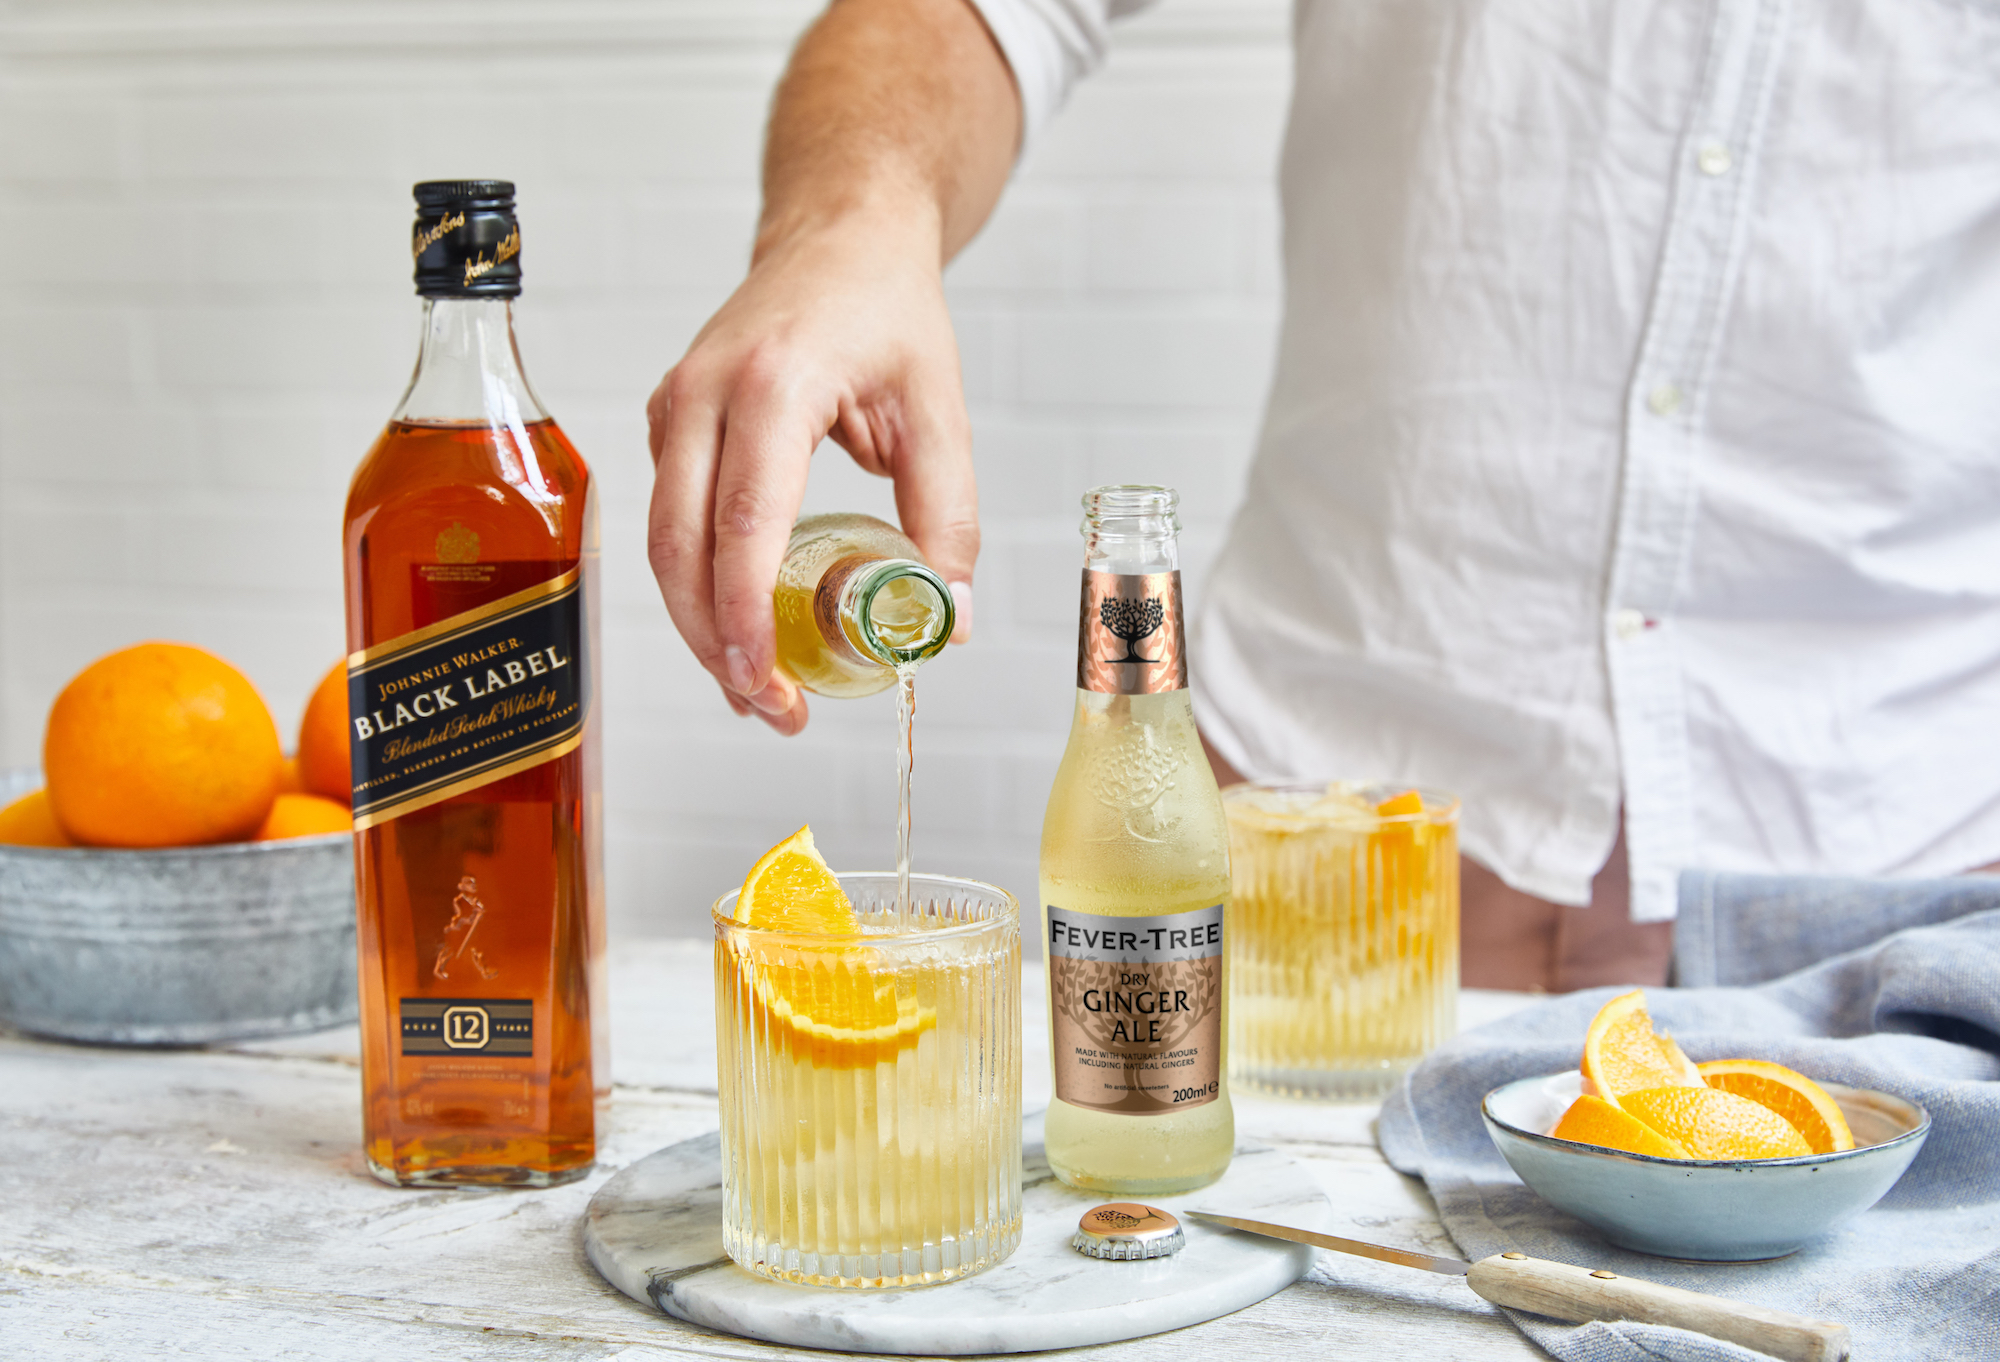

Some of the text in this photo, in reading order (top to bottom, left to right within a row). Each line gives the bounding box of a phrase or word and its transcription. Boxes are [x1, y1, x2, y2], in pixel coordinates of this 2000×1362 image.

[378, 636, 521, 701] JOHNNIE WALKER
[354, 645, 568, 741] BLACK LABEL
[382, 685, 557, 764] Blended Scotch Whisky
[1052, 919, 1220, 951] FEVER-TREE
[1121, 973, 1150, 986] DRY
[1083, 989, 1190, 1014] GINGER
[453, 1014, 480, 1040] 12
[1110, 1020, 1162, 1043] ALE
[1075, 1047, 1198, 1061] MADE WITH NATURAL FLAVOURS
[1079, 1057, 1195, 1070] INCLUDING NATURAL GINGERS
[1172, 1083, 1207, 1103] 200ml
